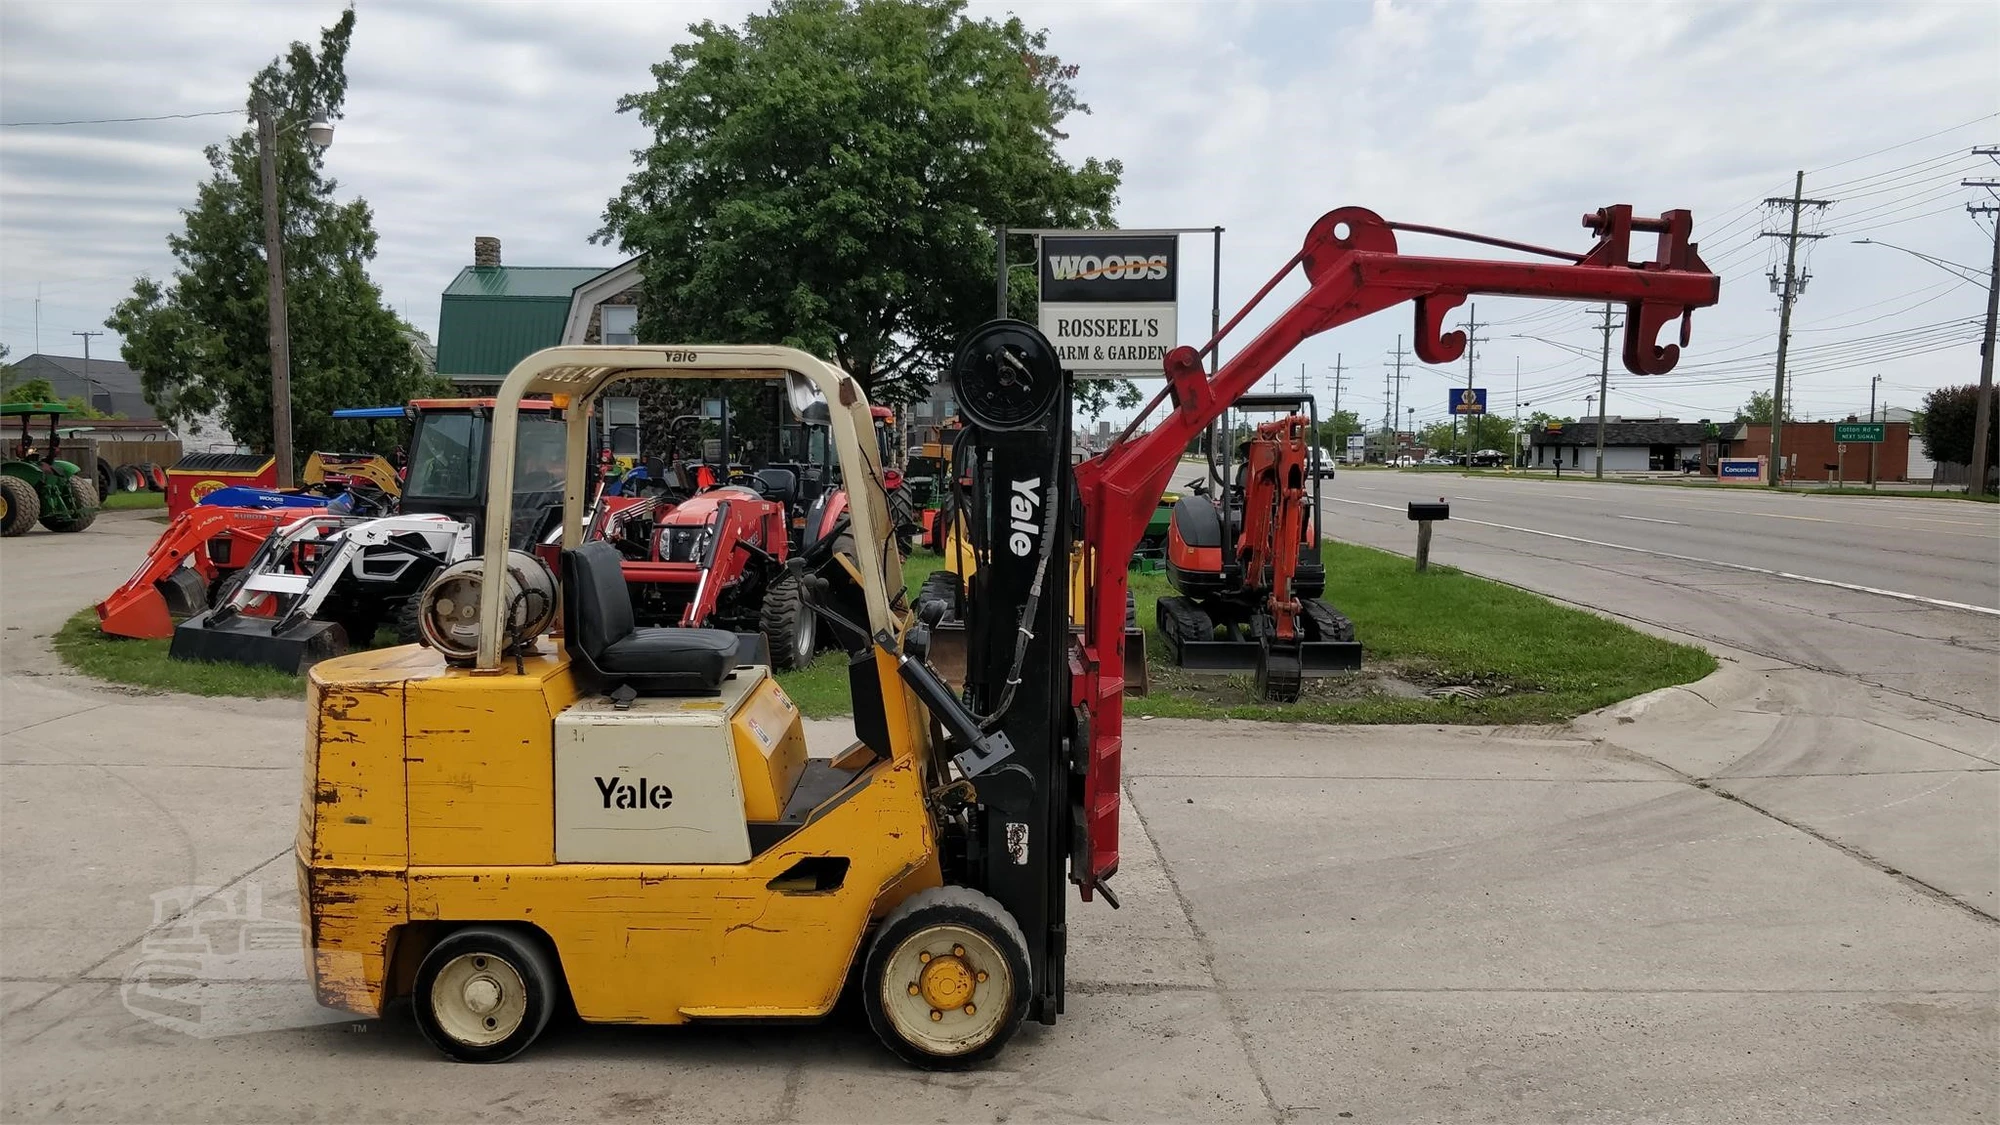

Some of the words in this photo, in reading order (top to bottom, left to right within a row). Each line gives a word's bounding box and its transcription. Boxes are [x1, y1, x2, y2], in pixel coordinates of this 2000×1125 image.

[1049, 255, 1168, 281] WOODS
[1057, 318, 1159, 338] ROSSEEL'S
[664, 350, 698, 363] Yale
[1093, 345, 1105, 361] &
[1108, 345, 1168, 361] GARDEN
[1009, 477, 1041, 557] Yale
[594, 776, 673, 810] Yale
